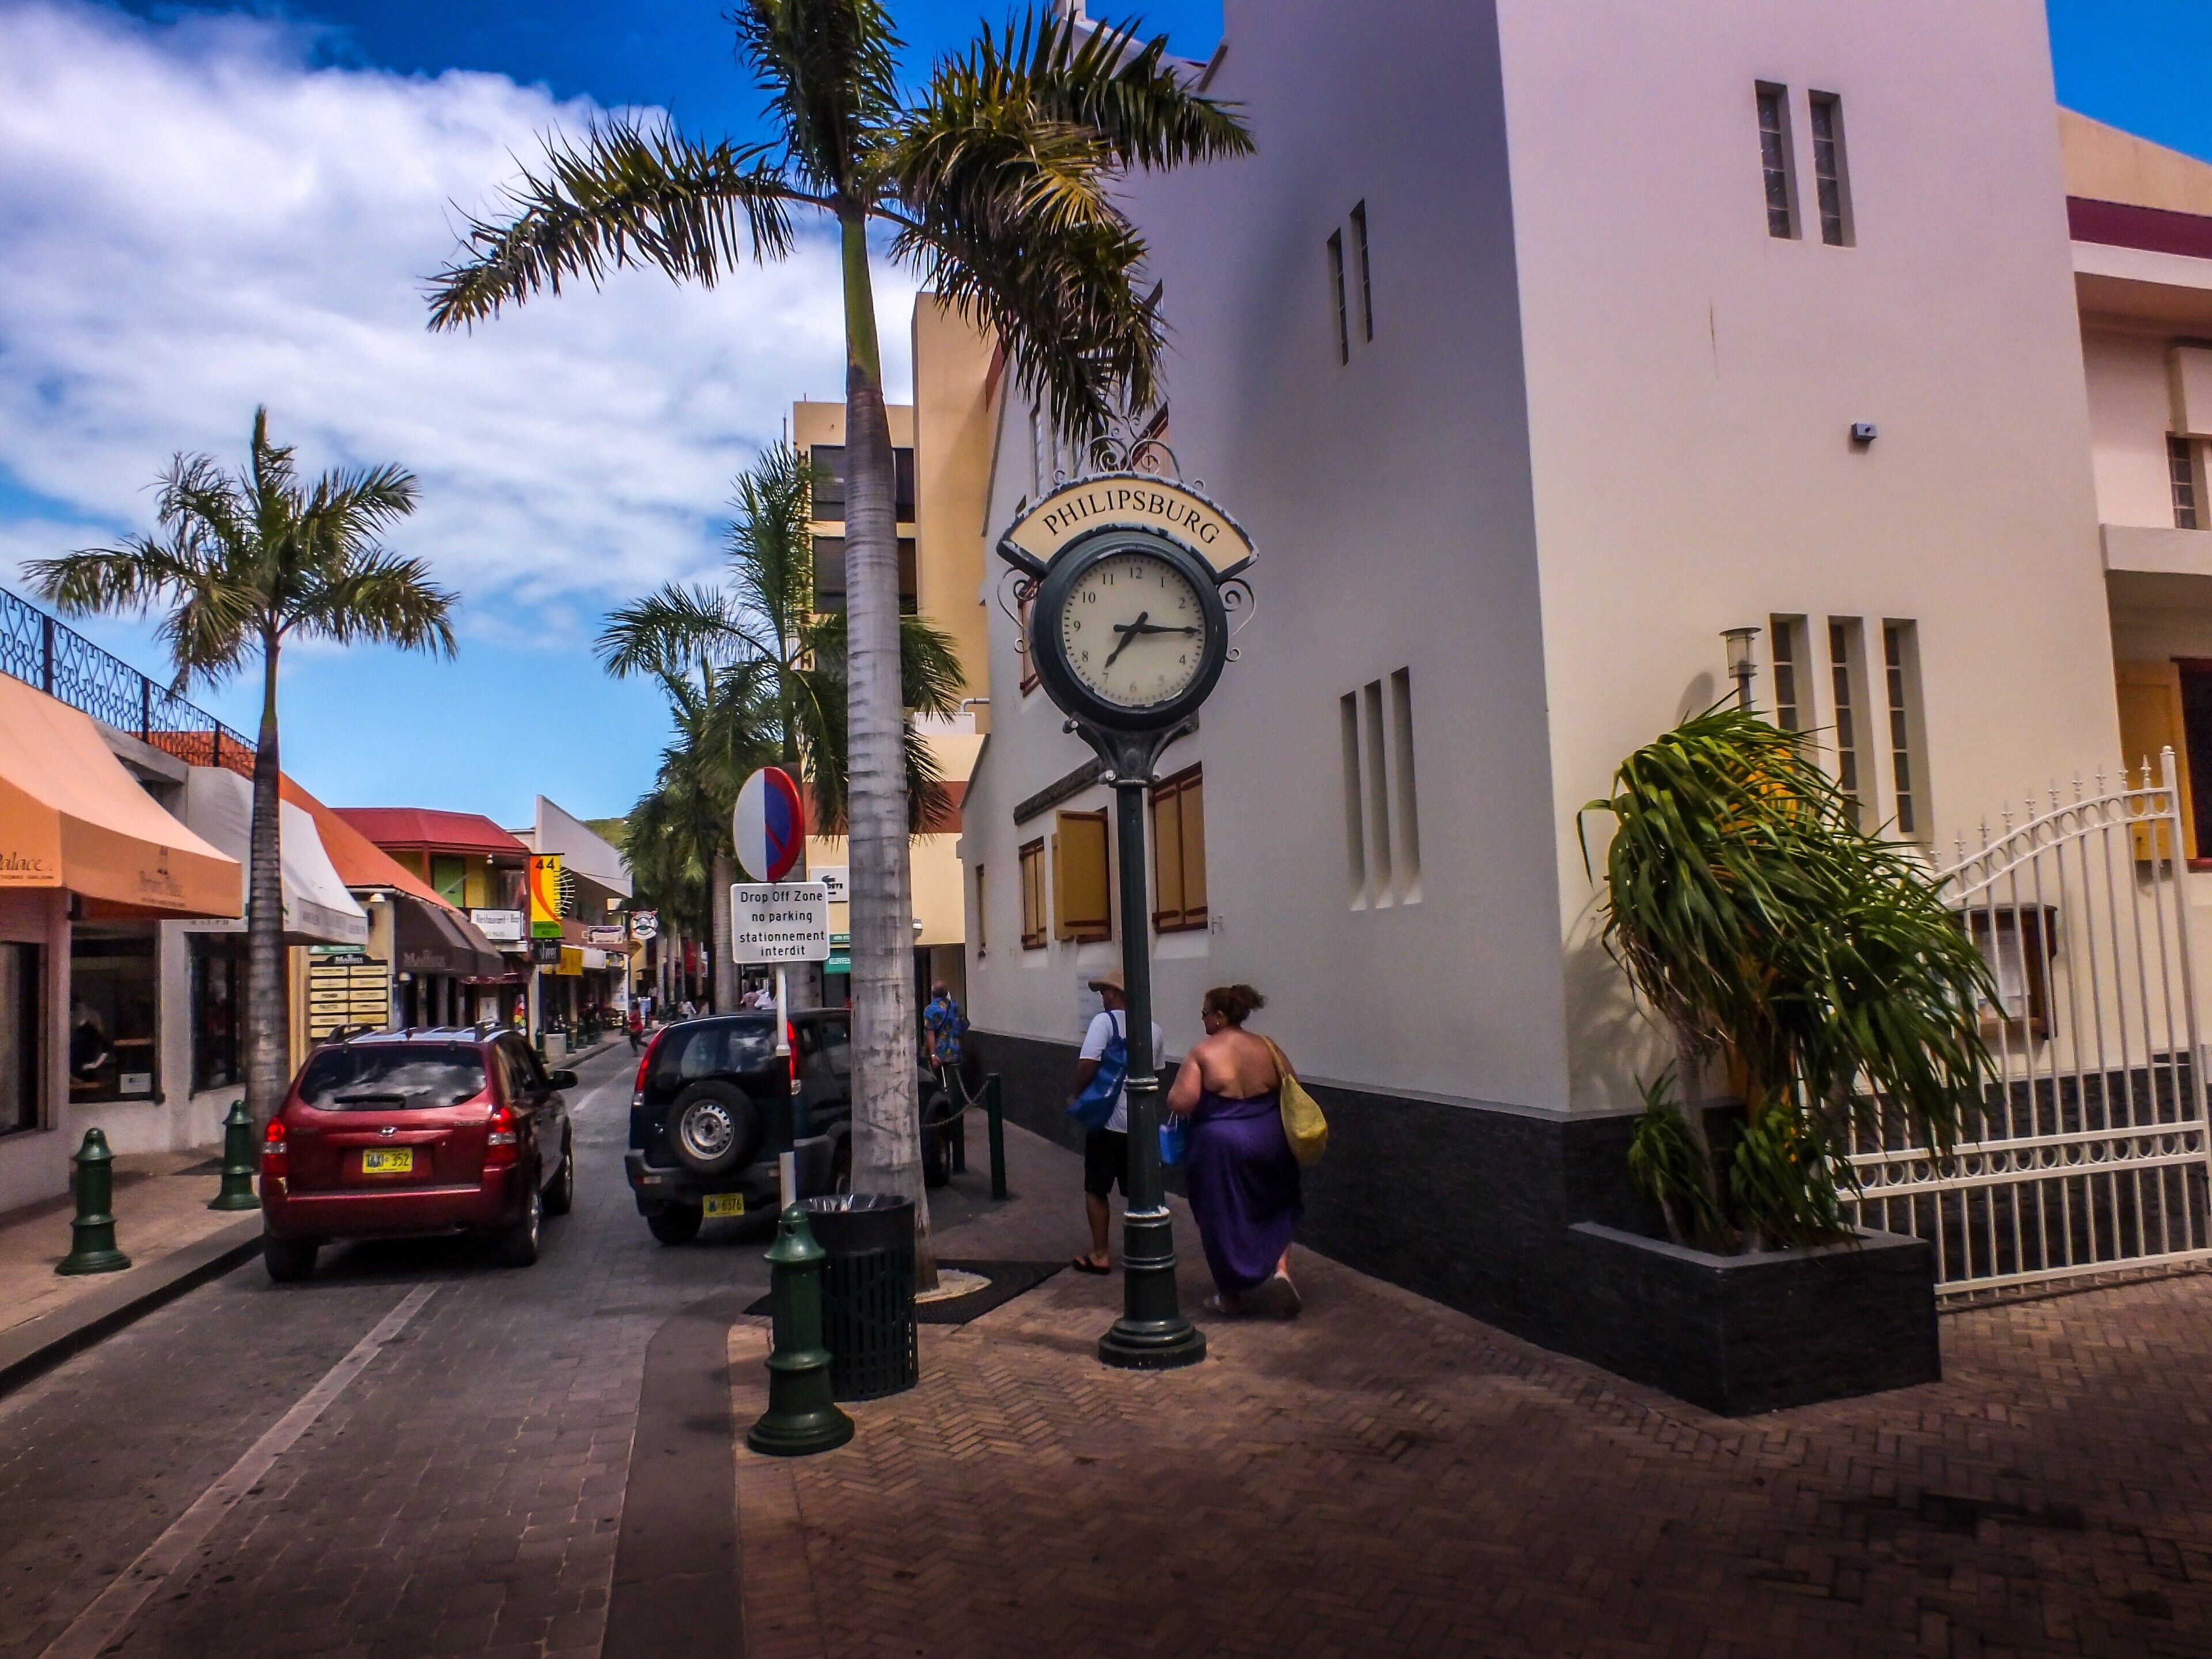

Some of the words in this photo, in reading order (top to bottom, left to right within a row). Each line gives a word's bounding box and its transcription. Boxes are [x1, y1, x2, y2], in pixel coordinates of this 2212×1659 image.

[1042, 490, 1220, 544] PHILIPSBURG
[1130, 567, 1142, 578] 12
[1103, 574, 1114, 585] 11
[1082, 592, 1096, 604] 10
[1179, 597, 1185, 609] 2
[1074, 620, 1081, 631] 9
[1082, 652, 1089, 662] 8
[1179, 655, 1185, 665] 4
[1103, 672, 1108, 683] 7
[1130, 681, 1137, 692] 6
[535, 858, 555, 870] 44
[741, 891, 768, 904] Drop
[772, 891, 789, 902] Off
[794, 891, 823, 902] Zone
[752, 914, 764, 922] no
[769, 911, 812, 923] parking
[740, 931, 824, 942] stationnement
[761, 945, 805, 956] interdit
